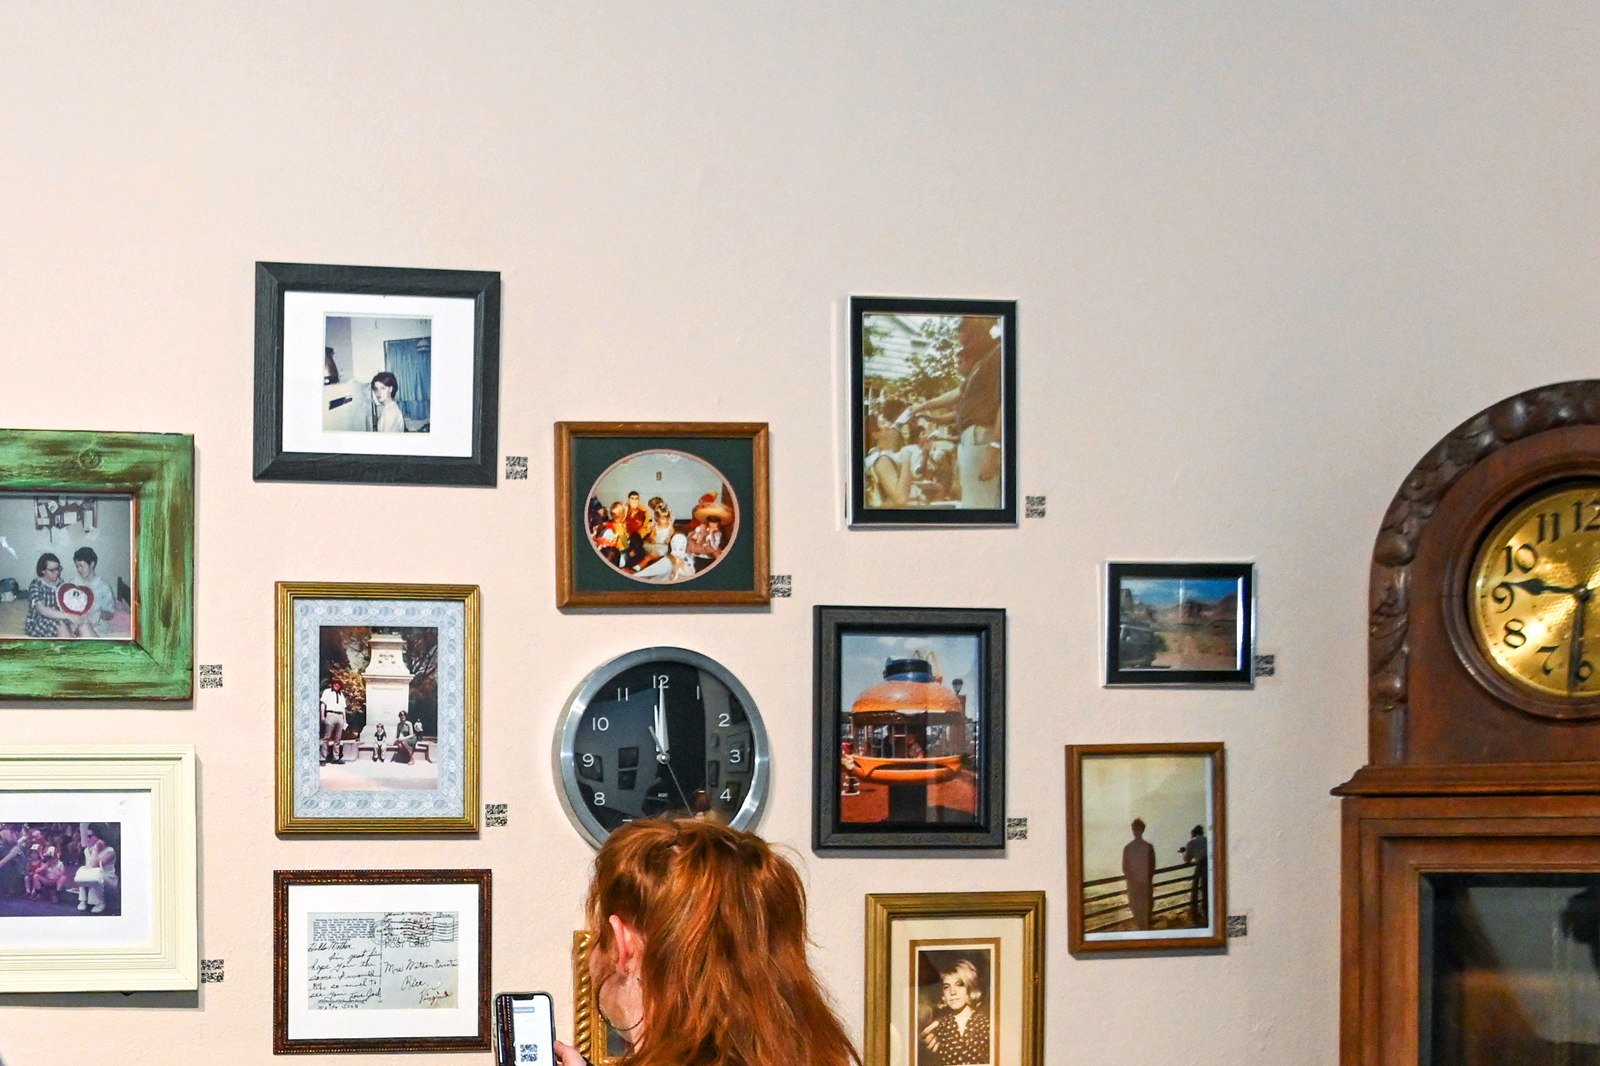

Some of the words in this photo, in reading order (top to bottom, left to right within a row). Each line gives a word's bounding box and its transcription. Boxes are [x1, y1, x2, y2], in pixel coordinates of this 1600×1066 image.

[1572, 500, 1600, 534] 12
[1536, 511, 1562, 545] 11
[1502, 543, 1538, 576] 10
[1492, 581, 1515, 614] 9
[1503, 618, 1527, 650] 8
[1536, 644, 1560, 676] 7
[652, 674, 670, 689] 12
[617, 687, 629, 702] 11
[592, 717, 610, 731] 10
[718, 713, 731, 727] 2
[582, 753, 595, 767] 9
[729, 749, 741, 764] 3
[593, 792, 606, 806] 8
[719, 788, 732, 802] 4
[384, 941, 404, 949] POST
[408, 941, 431, 949] CARD
